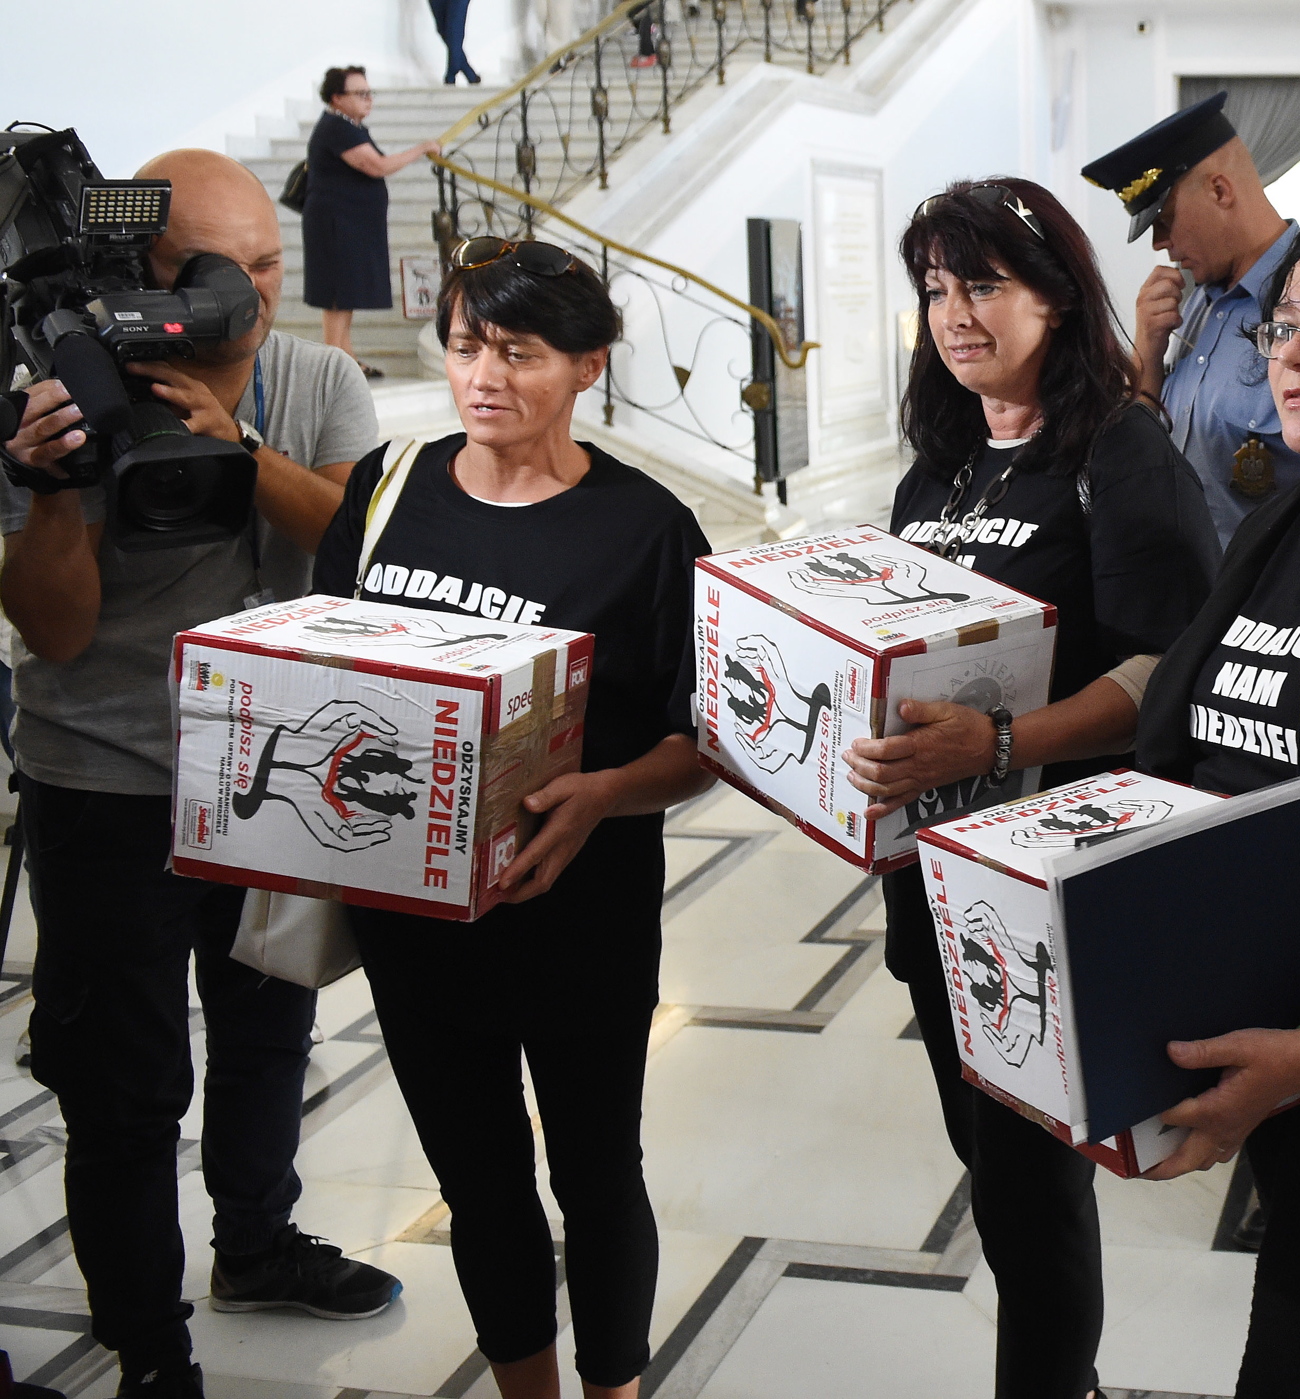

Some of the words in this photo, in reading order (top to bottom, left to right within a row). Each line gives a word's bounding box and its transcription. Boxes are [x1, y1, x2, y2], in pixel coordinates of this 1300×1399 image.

[122, 325, 150, 333] SONY
[728, 533, 884, 570] NIEDZIELE
[749, 534, 838, 555] ODZYSKAJMY
[364, 562, 547, 625] ODDAJCIE
[861, 605, 923, 626] podpisz
[927, 599, 949, 608] się
[221, 599, 351, 636] NIEDZIELE
[697, 615, 705, 713] ODZYSKAJMY
[706, 586, 720, 753] NIEDZIELE
[1211, 661, 1289, 707] NAM
[236, 680, 255, 757] podpisz
[819, 711, 832, 739] się
[226, 741, 234, 772] USTAWY
[233, 761, 252, 789] się
[817, 741, 829, 812] podpisz
[423, 698, 460, 890] NIEDZIELE
[455, 740, 474, 855] ODZYSKAJMY
[953, 777, 1142, 833] NIEDZIELE
[983, 785, 1091, 819] ODZYSKAJMY
[930, 857, 974, 1058] NIEDZIELE
